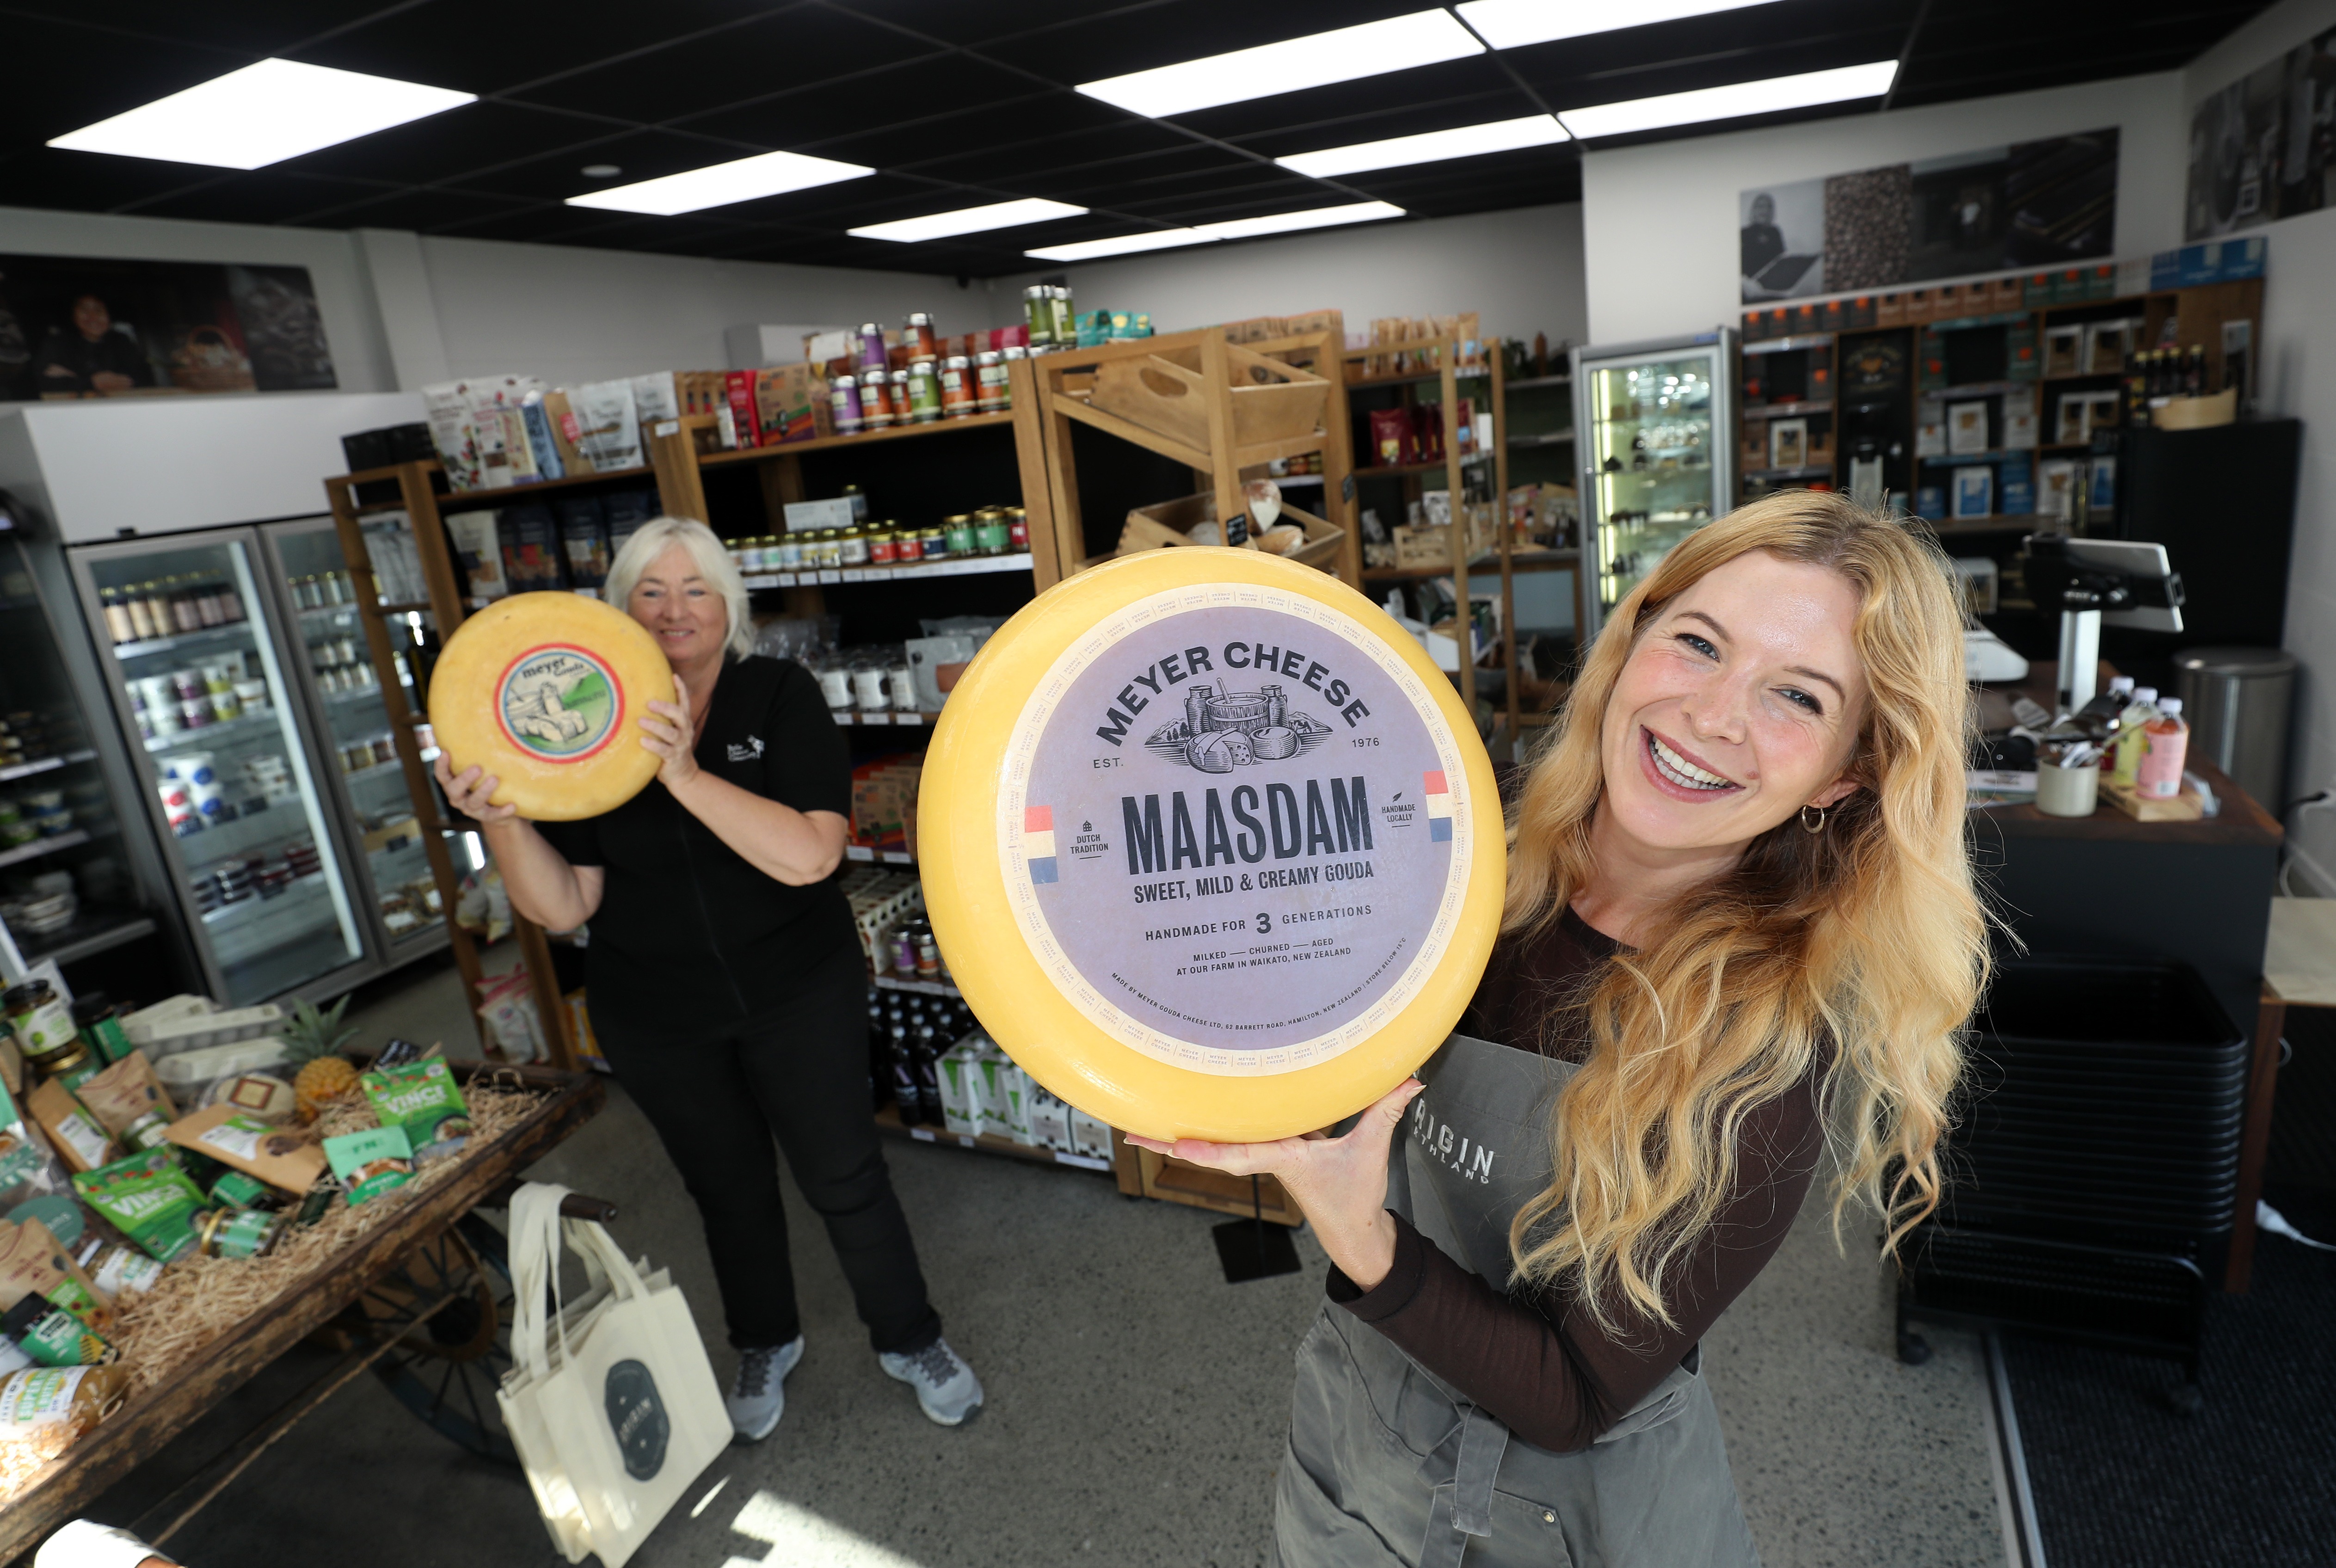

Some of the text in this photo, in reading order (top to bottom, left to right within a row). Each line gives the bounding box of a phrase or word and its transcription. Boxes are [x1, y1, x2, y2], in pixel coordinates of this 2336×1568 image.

[523, 656, 565, 678] meyer
[1096, 642, 1371, 747] MEYER CHEESE
[1093, 738, 1380, 769] EST. 1976
[1381, 804, 1416, 813] HANDMADE
[1387, 813, 1413, 822] LOCALLY
[1076, 834, 1100, 843] DUTCH
[1122, 776, 1373, 875] MAASDAM
[1070, 843, 1109, 854] TRADITION
[1134, 861, 1374, 903] SWEET, MILD & CREAMY GOUDA
[1145, 905, 1372, 941] HANDMADE FOR 3 GENERATIONS
[1176, 947, 1351, 976] AT OUR FARM IN WAIKATO, NEW ZEALAND
[1193, 938, 1334, 962] MILKED CHURNED AGED
[1112, 972, 1128, 988] MADE
[1128, 985, 1137, 994] BY
[1137, 992, 1158, 1008] MEYER
[1159, 1005, 1180, 1018] GOUDA
[1182, 1015, 1208, 1026] CHEESE
[1288, 1011, 1322, 1025] HAMILTON,
[1323, 1003, 1336, 1013] NEW
[1337, 987, 1362, 1006] ZEALAND
[1365, 968, 1383, 985] STORE
[1382, 951, 1397, 969] BELOW
[1414, 1098, 1494, 1176] RIGIN
